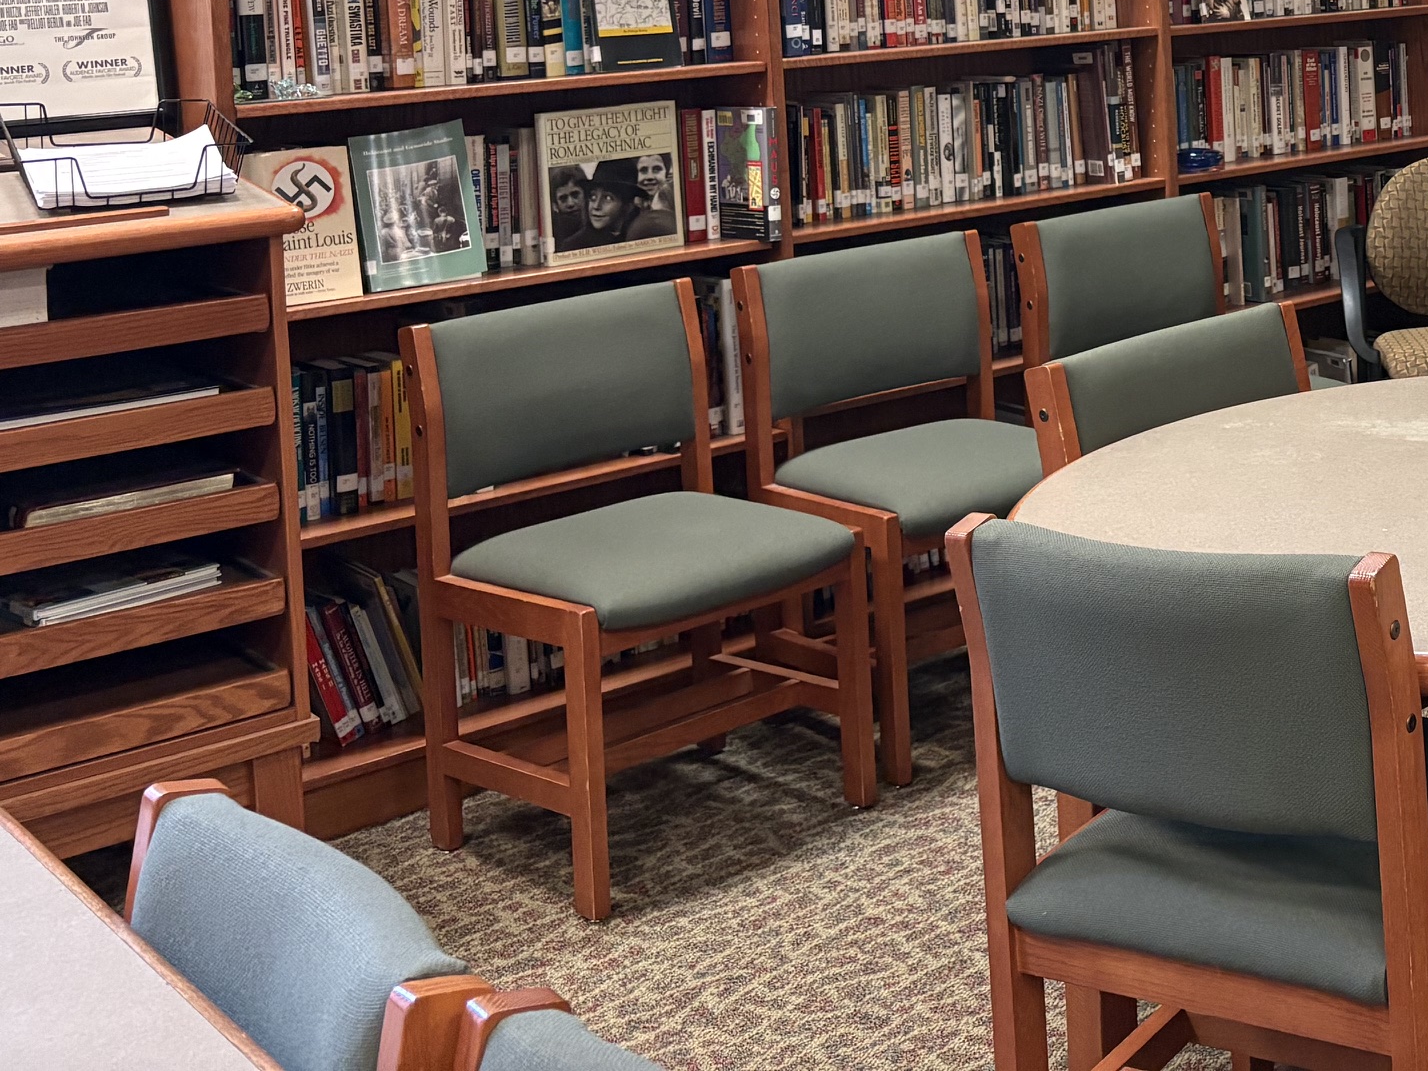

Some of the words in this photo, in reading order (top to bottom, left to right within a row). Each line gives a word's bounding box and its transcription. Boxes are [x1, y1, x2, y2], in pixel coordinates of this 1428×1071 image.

[61, 3, 80, 15] ROBERT
[87, 2, 109, 13] JOHNSON
[73, 16, 81, 27] JOE
[348, 5, 364, 47] SWASTIKA
[399, 9, 410, 47] DREAM
[531, 14, 541, 40] Power
[96, 33, 116, 41] GROUP
[316, 29, 329, 67] GHETTO
[76, 58, 128, 70] WINNER
[547, 117, 565, 131] TO
[568, 114, 594, 129] GIVE
[599, 110, 633, 126] THEM
[636, 106, 669, 120] LIGHT
[405, 140, 432, 150] Genocide
[433, 136, 453, 145] Studies
[548, 131, 575, 145] THE
[578, 126, 621, 142] LEGACY
[625, 124, 640, 136] OF
[549, 142, 594, 160] ROMAN
[597, 136, 652, 154] VISHNIAC
[768, 137, 779, 186] MAUS
[315, 232, 354, 248] Louis
[309, 252, 326, 261] THE
[328, 248, 354, 259] NAZIS
[287, 279, 325, 294] ZWERIN
